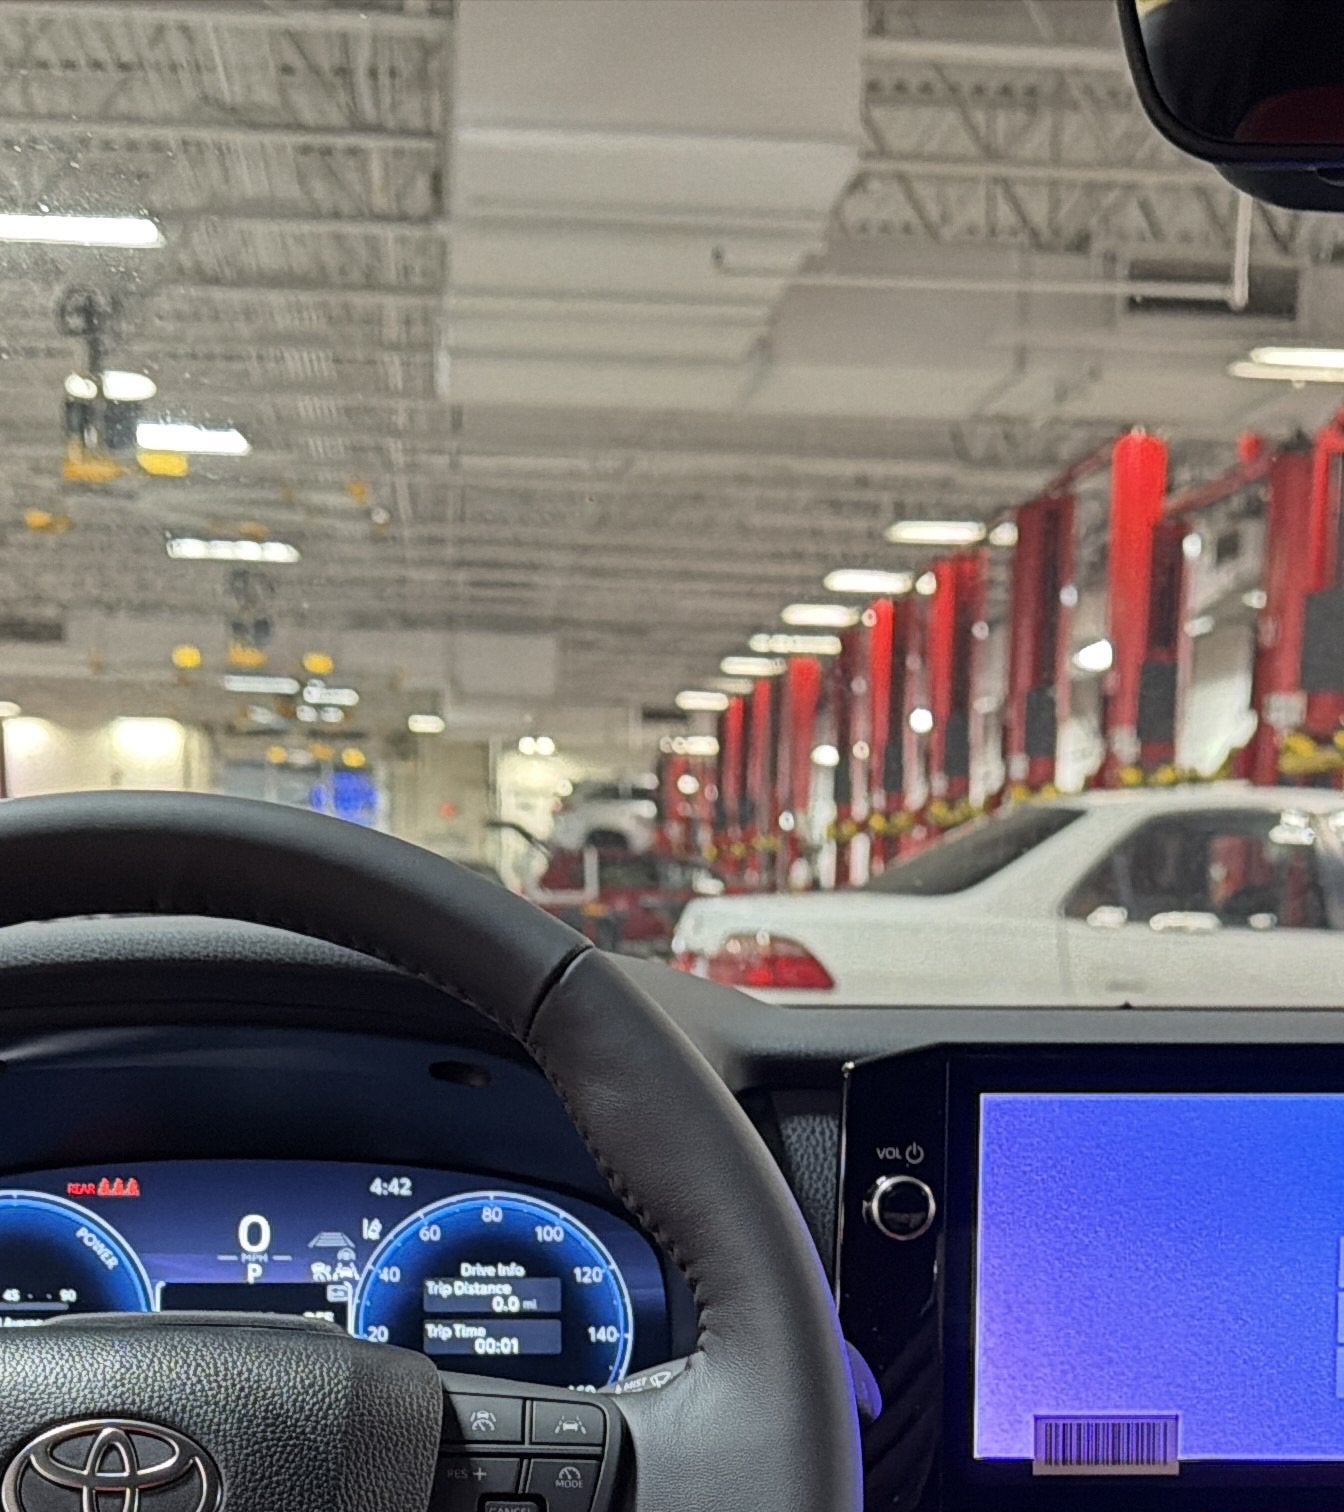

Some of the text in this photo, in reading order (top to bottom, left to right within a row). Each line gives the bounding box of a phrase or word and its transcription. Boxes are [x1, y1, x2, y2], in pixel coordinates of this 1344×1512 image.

[875, 1146, 903, 1160] VOL
[369, 1177, 413, 1197] 4:42
[481, 1206, 503, 1223] 80
[419, 1225, 442, 1242] 60
[535, 1225, 565, 1243] 100
[76, 1227, 119, 1270] POWER
[247, 1263, 263, 1284] P
[379, 1266, 401, 1283] 40
[460, 1262, 526, 1278] Drive Info
[573, 1266, 603, 1283] 120
[425, 1281, 513, 1298] Trip Distance
[491, 1297, 520, 1313] 0.0
[367, 1325, 390, 1344] 20
[425, 1323, 487, 1340] Trip Time
[588, 1326, 618, 1343] 140
[474, 1338, 520, 1356] 00:01
[555, 1479, 584, 1489] MODE
